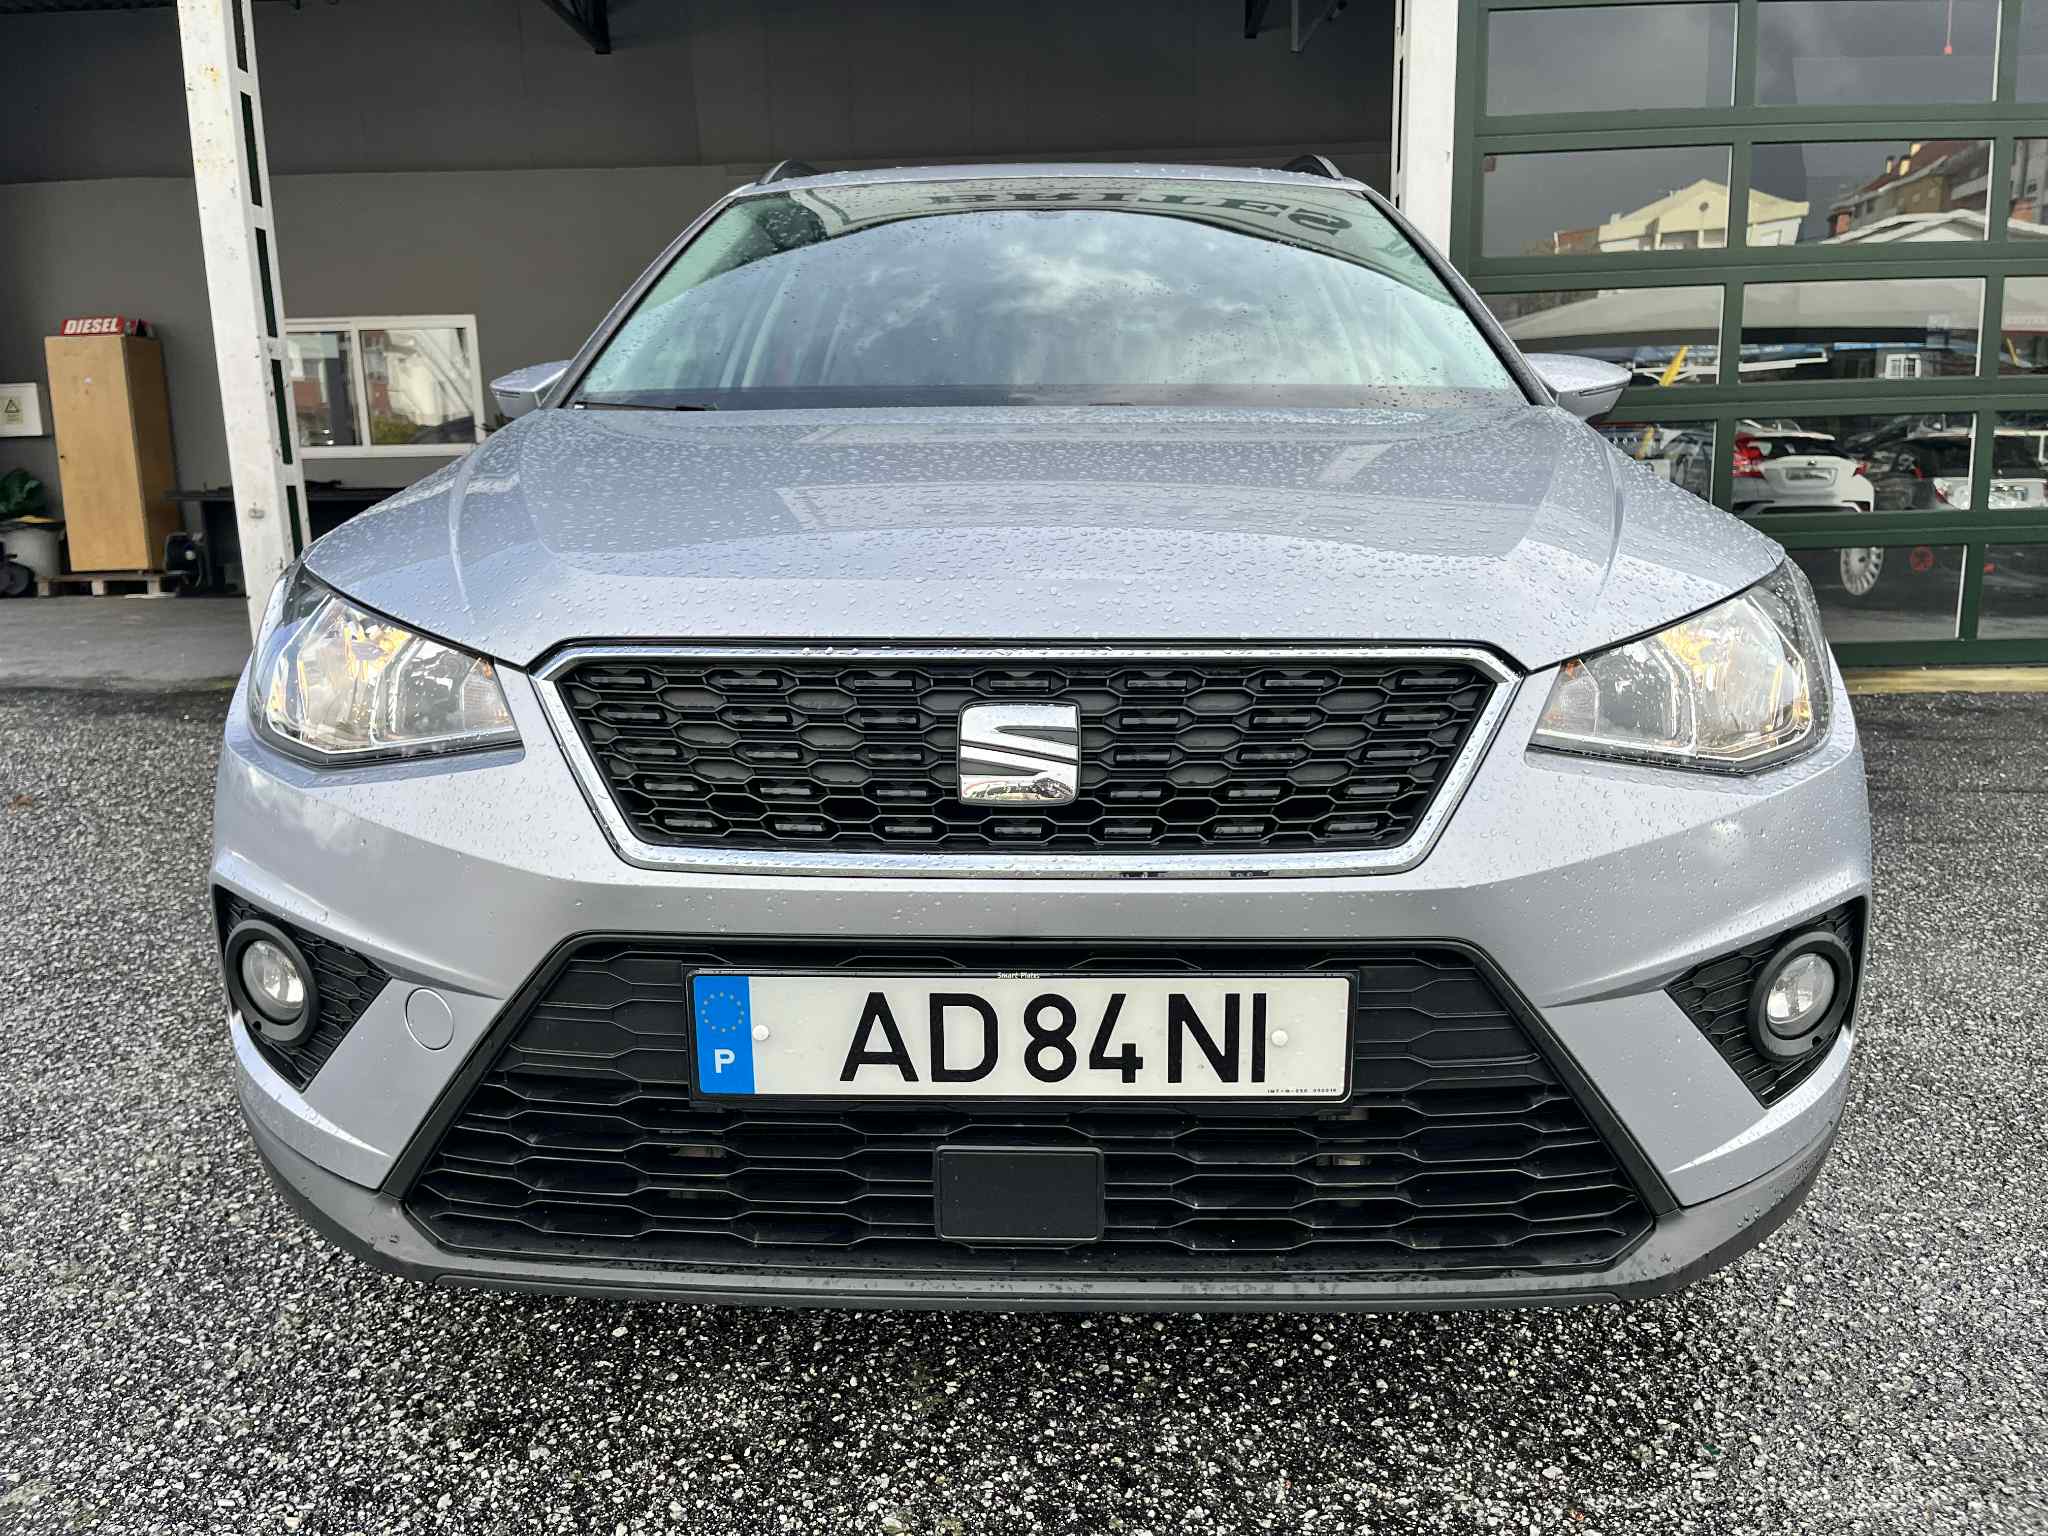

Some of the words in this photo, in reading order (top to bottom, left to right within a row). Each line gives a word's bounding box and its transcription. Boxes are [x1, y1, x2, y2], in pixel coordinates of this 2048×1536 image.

[64, 317, 119, 334] DIESEL
[839, 991, 998, 1083] AD
[1023, 993, 1144, 1083] 84
[1166, 993, 1267, 1083] NI
[714, 1048, 736, 1074] P
